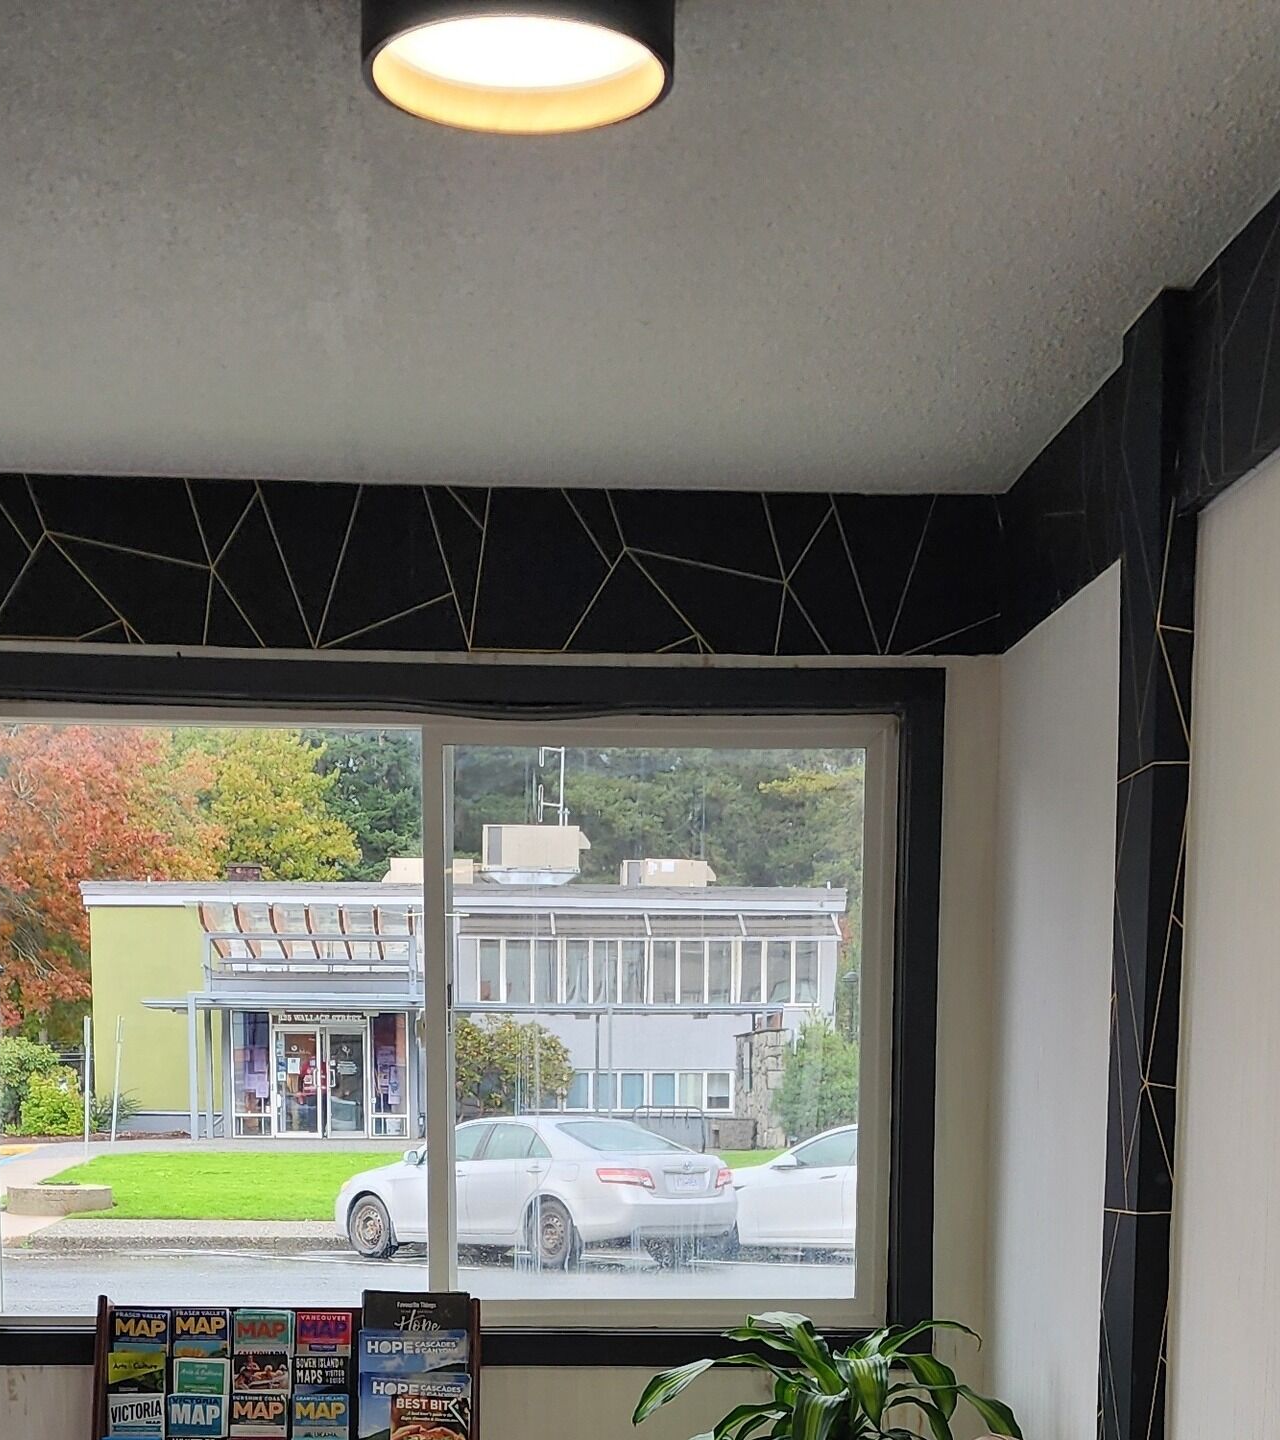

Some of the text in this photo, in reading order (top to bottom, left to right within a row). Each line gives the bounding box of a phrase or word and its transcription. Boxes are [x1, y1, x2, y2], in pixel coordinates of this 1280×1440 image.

[115, 1318, 166, 1337] MAP
[175, 1316, 226, 1335] MAP
[236, 1321, 286, 1339] MAP
[300, 1321, 347, 1339] MAP
[367, 1340, 413, 1354] HOPE
[296, 1358, 339, 1368] BOWEN ISLAND
[296, 1369, 323, 1384] MAPS
[372, 1381, 461, 1395] HOPE CASCADES
[111, 1400, 162, 1423] VICTORIA
[233, 1401, 284, 1420] MAP
[295, 1402, 346, 1420] MAP
[396, 1398, 428, 1410] BEST
[171, 1404, 220, 1425] MAP
